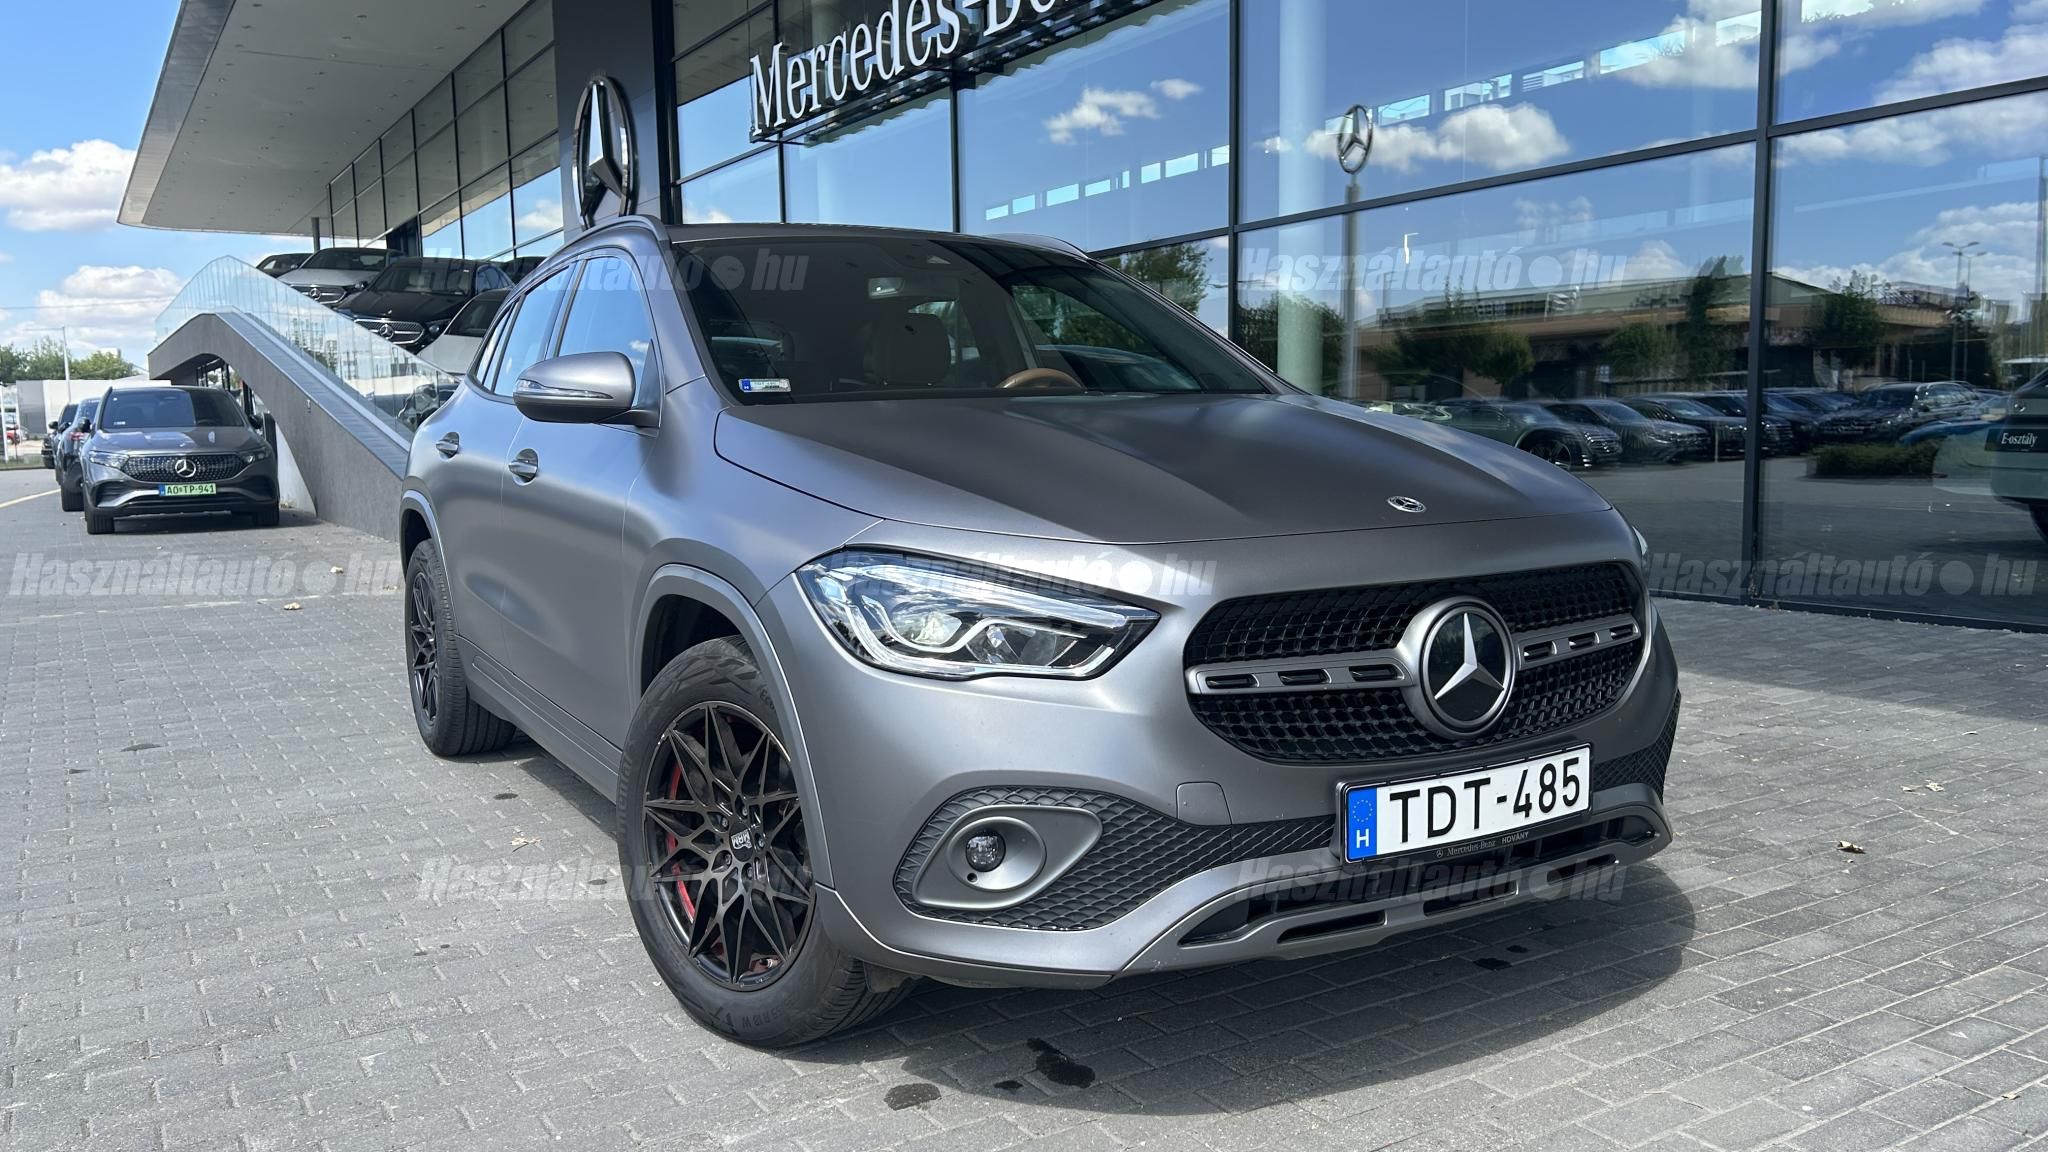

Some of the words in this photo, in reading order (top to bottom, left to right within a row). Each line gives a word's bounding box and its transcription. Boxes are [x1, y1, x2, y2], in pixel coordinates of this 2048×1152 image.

[1390, 757, 1580, 844] TDT-485
[1356, 828, 1369, 848] H
[1446, 840, 1496, 857] Mercedes-Benz
